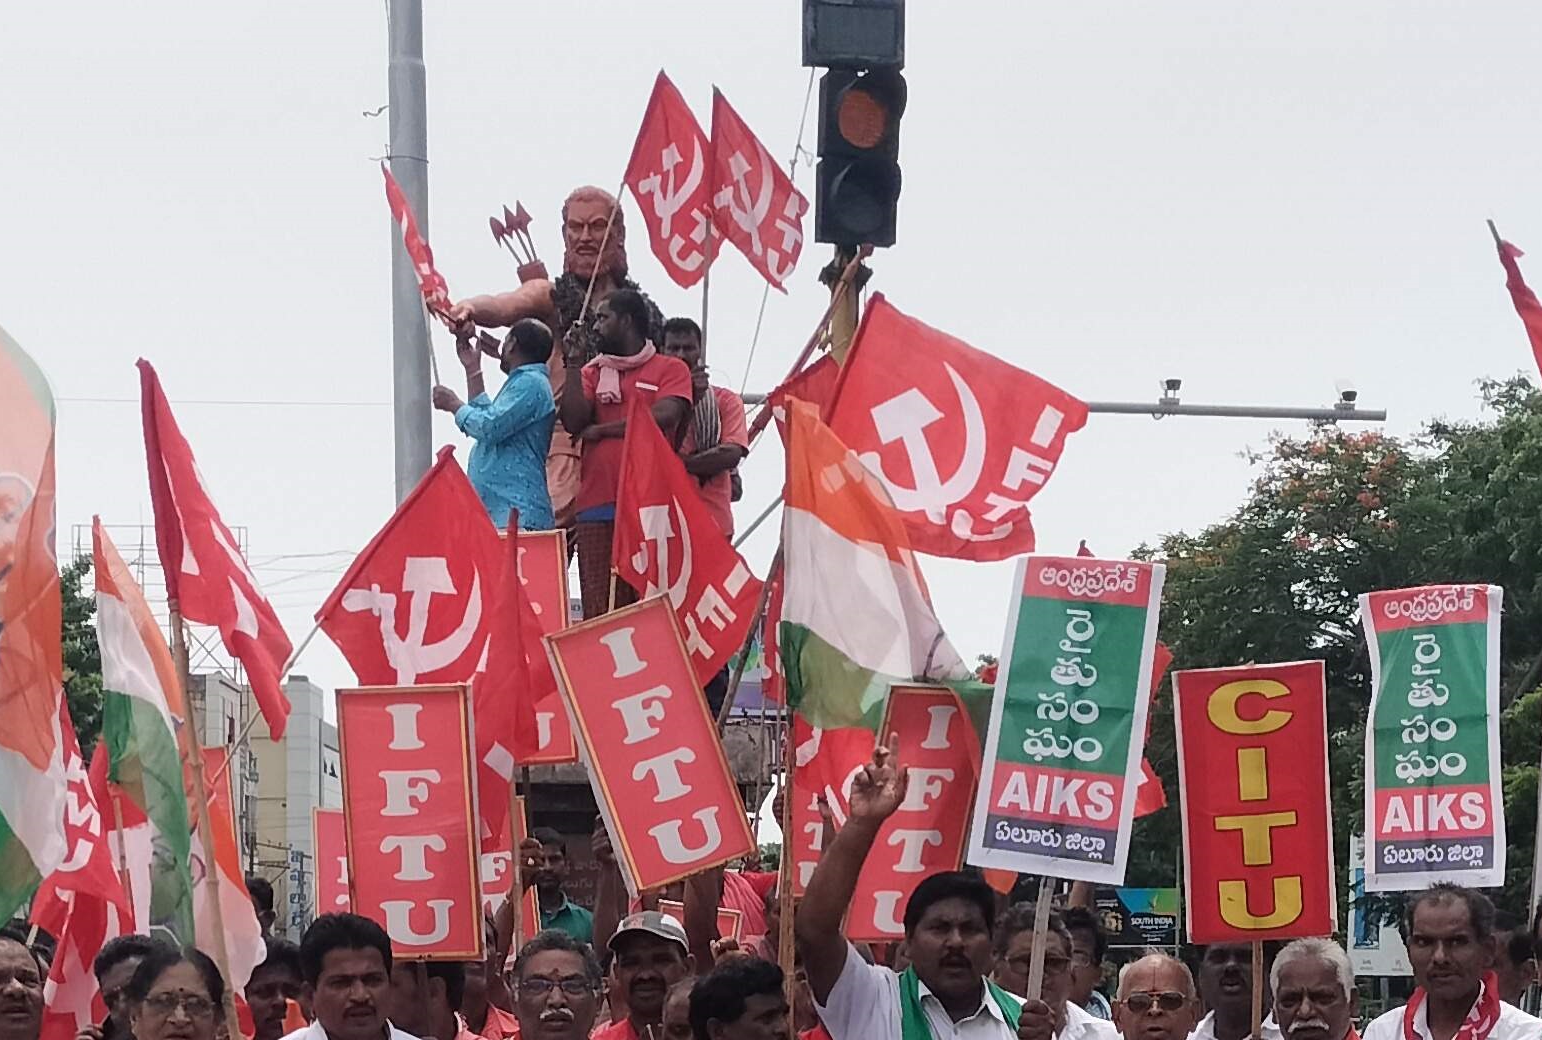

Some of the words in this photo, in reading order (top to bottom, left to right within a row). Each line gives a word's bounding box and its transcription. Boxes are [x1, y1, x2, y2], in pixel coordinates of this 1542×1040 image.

[379, 703, 455, 945] IFTU
[599, 627, 723, 865] IFTU
[997, 770, 1114, 821] AIKS
[1207, 679, 1305, 930] CITU
[1381, 791, 1486, 833] AIKS
